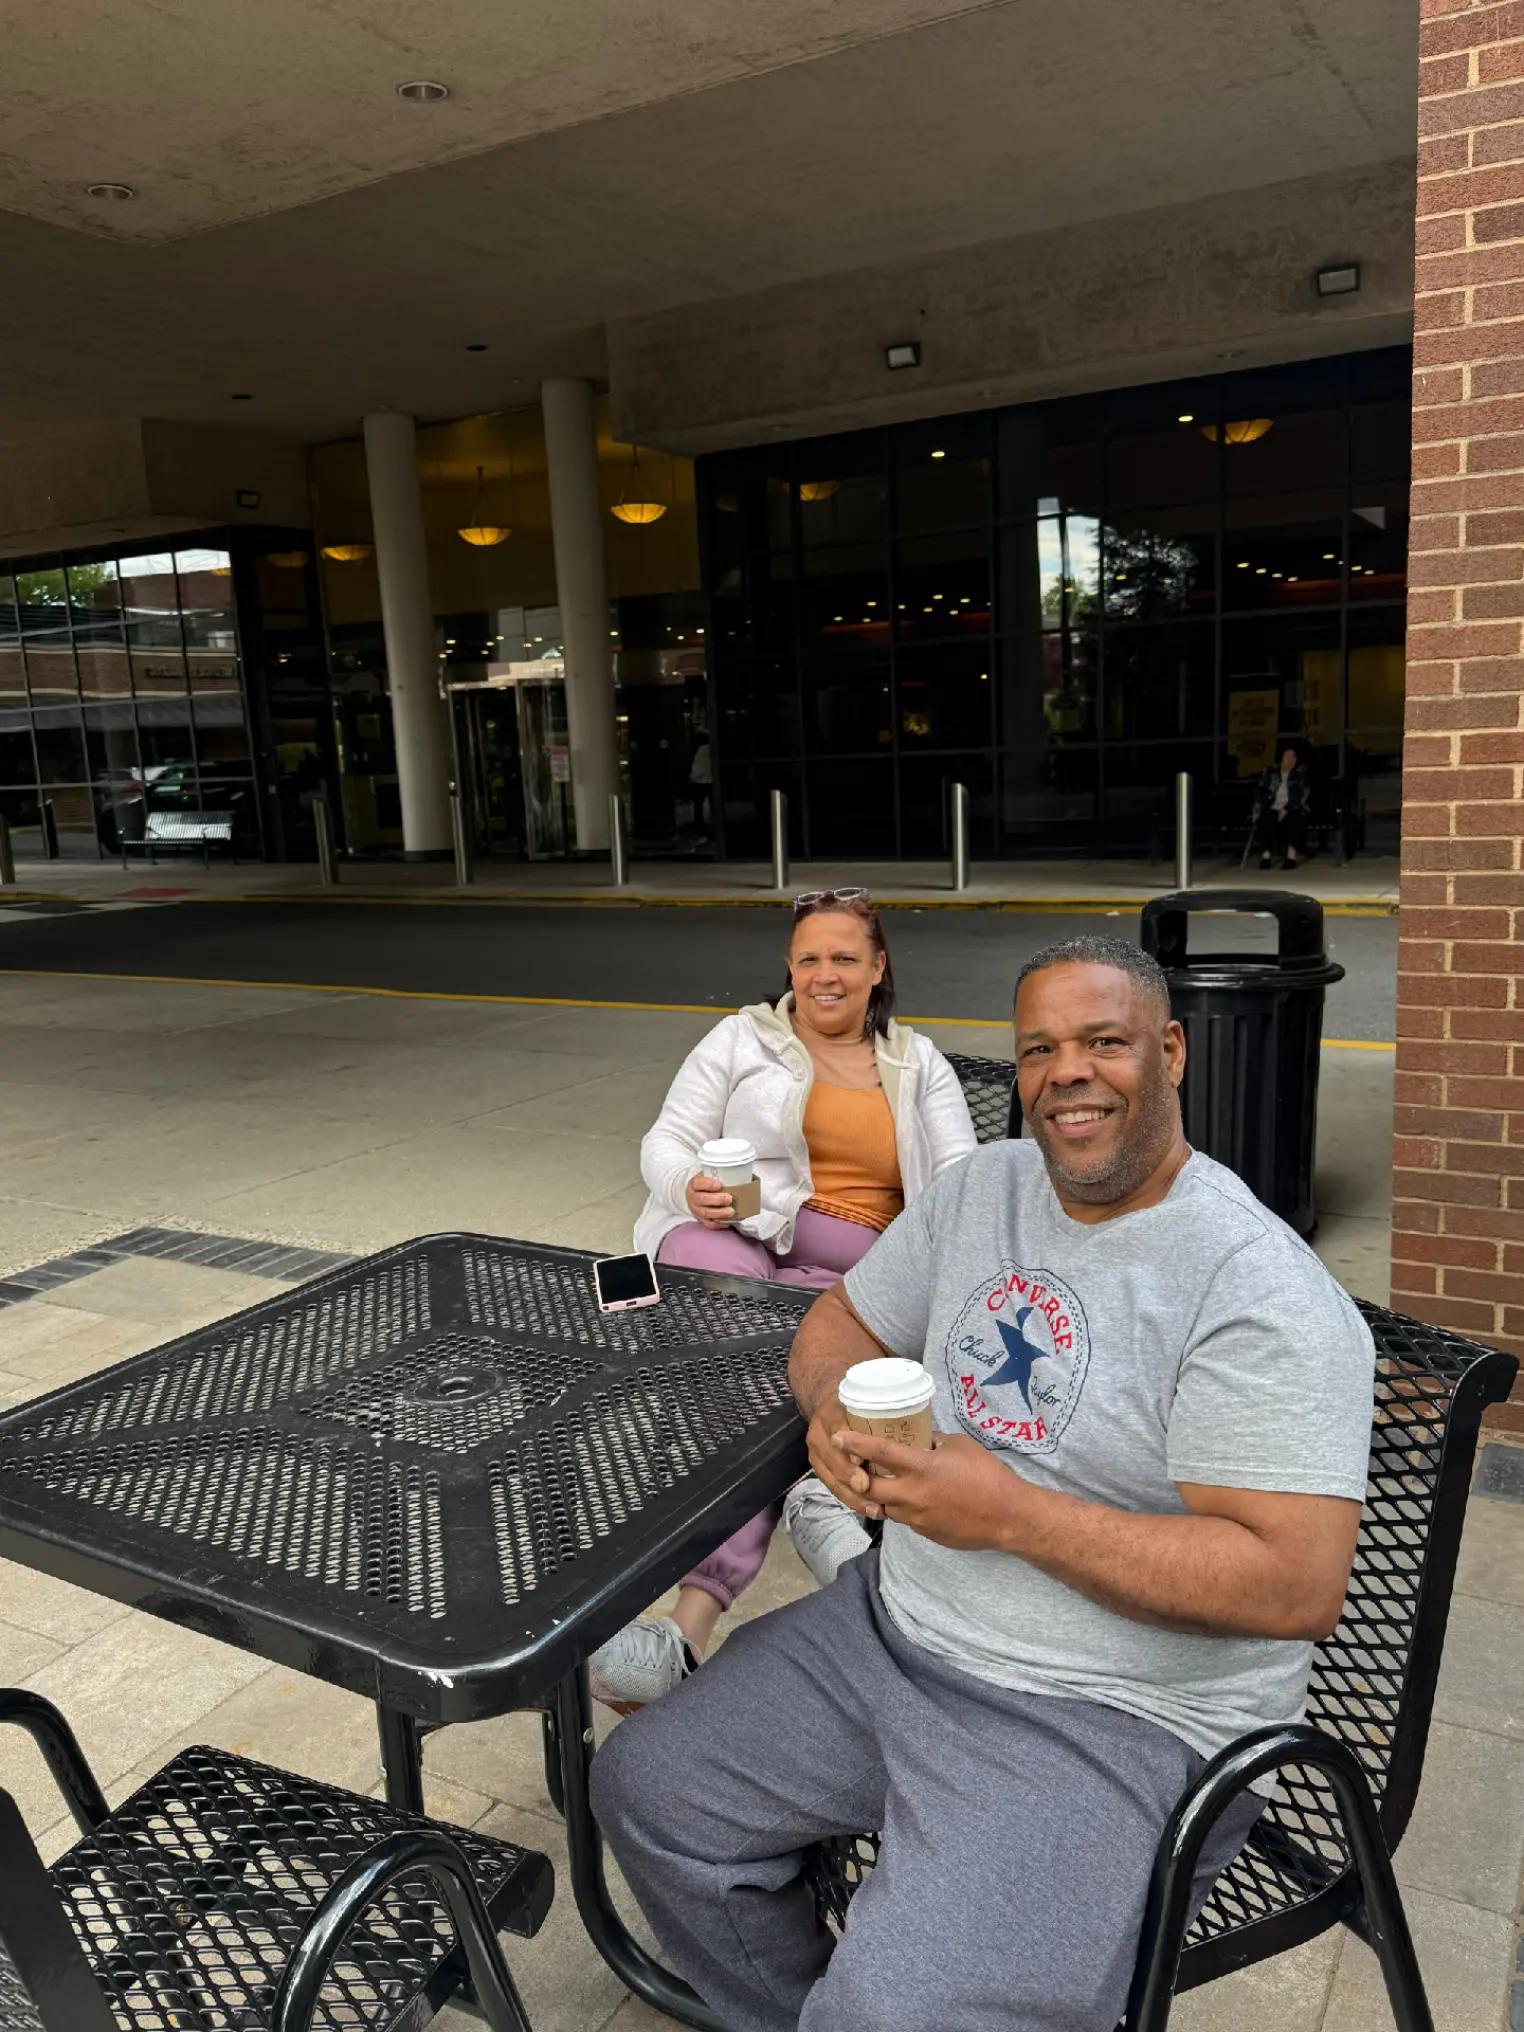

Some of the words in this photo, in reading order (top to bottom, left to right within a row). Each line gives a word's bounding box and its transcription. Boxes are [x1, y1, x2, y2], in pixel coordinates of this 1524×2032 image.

[987, 1274, 1072, 1354] CNVRSE
[959, 1336, 1005, 1367] Chuck
[961, 1375, 987, 1418] ALL
[979, 1416, 1049, 1441] STAR
